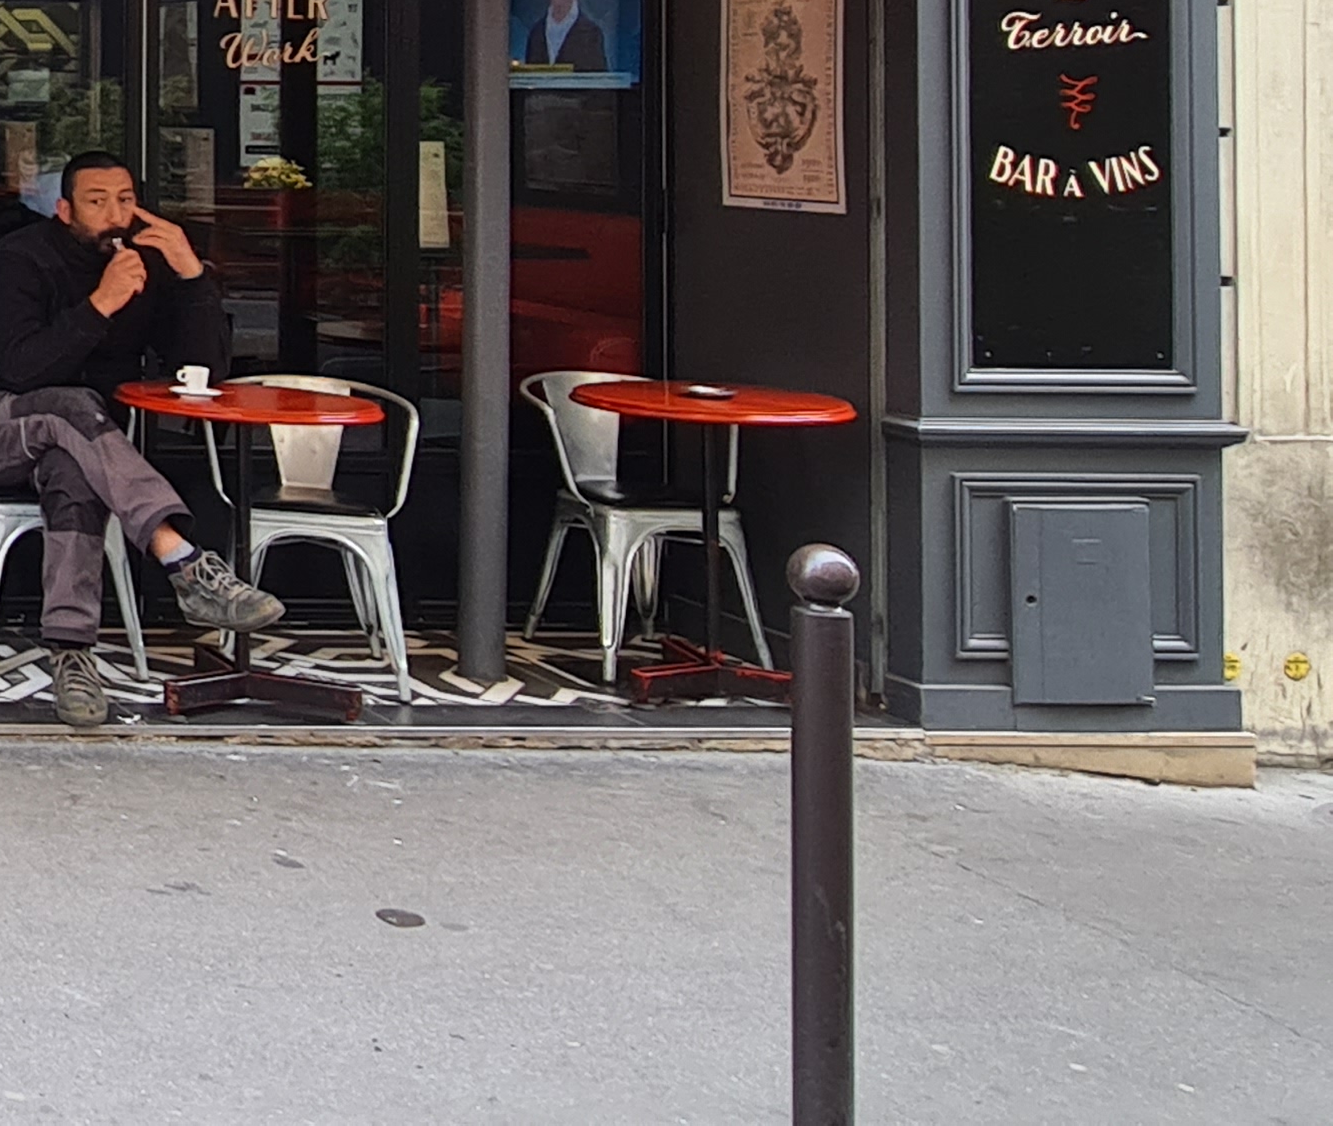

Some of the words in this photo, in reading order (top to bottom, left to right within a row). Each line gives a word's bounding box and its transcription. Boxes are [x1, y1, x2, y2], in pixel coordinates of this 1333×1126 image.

[220, 27, 330, 70] Work
[1000, 10, 1148, 50] Terroir
[988, 145, 1056, 197] BAR
[1087, 145, 1161, 195] VINS
